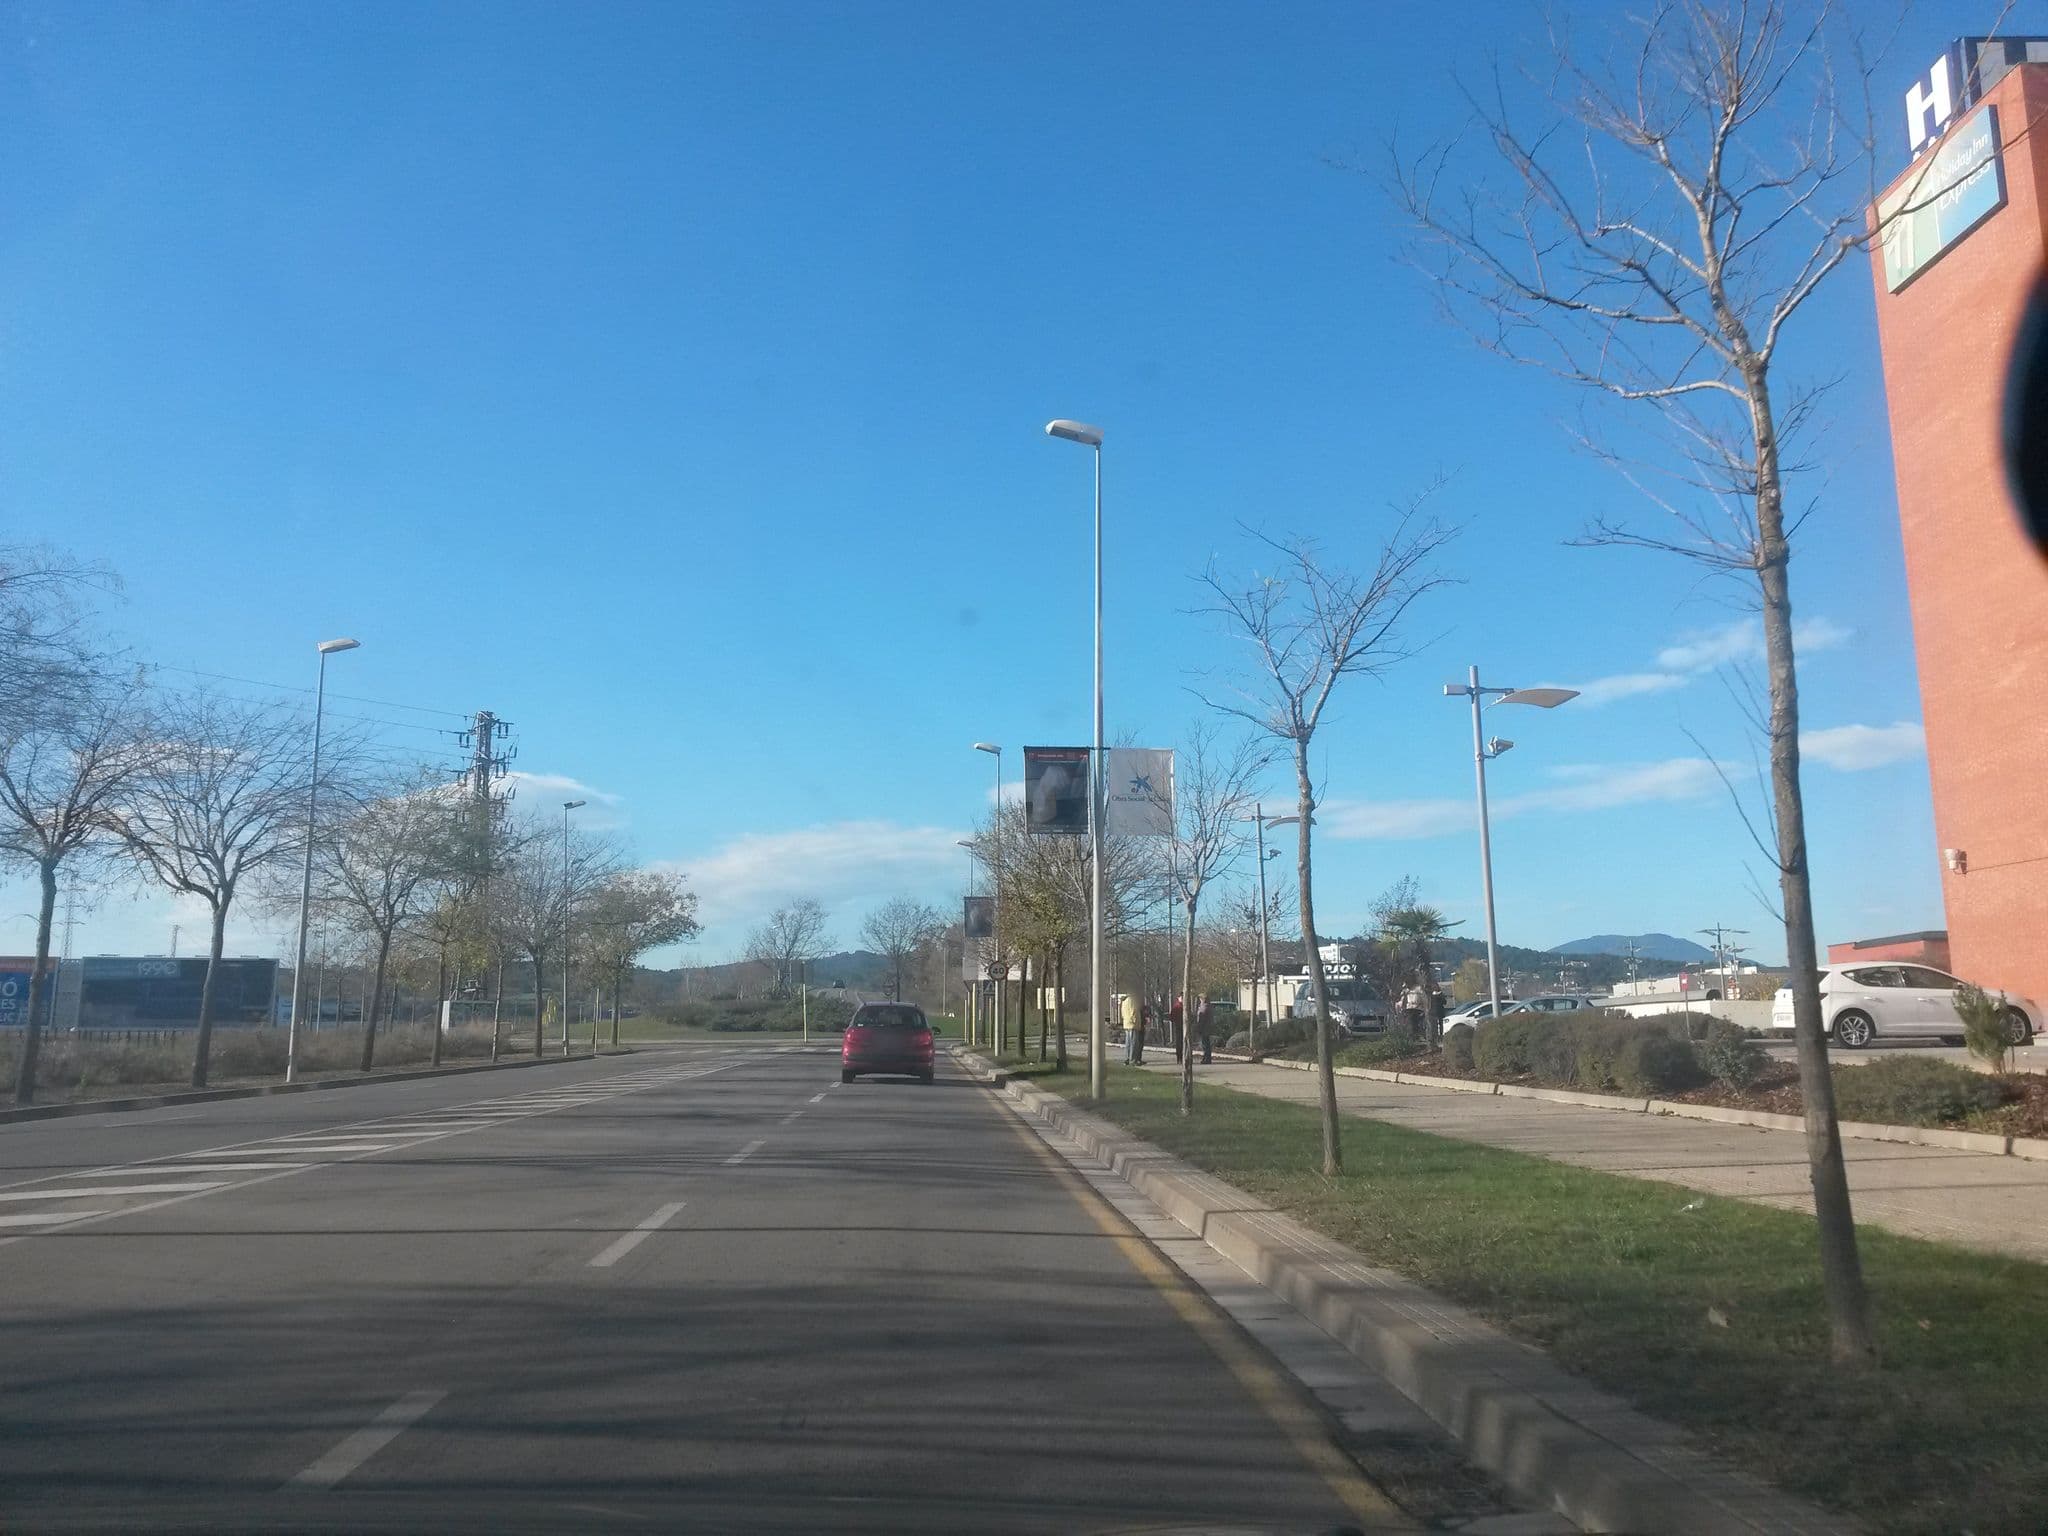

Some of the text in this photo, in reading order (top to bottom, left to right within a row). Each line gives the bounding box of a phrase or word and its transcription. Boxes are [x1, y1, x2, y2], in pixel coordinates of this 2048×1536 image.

[1905, 54, 1951, 151] H
[1972, 133, 1988, 155] Inn
[992, 967, 1005, 975] 40
